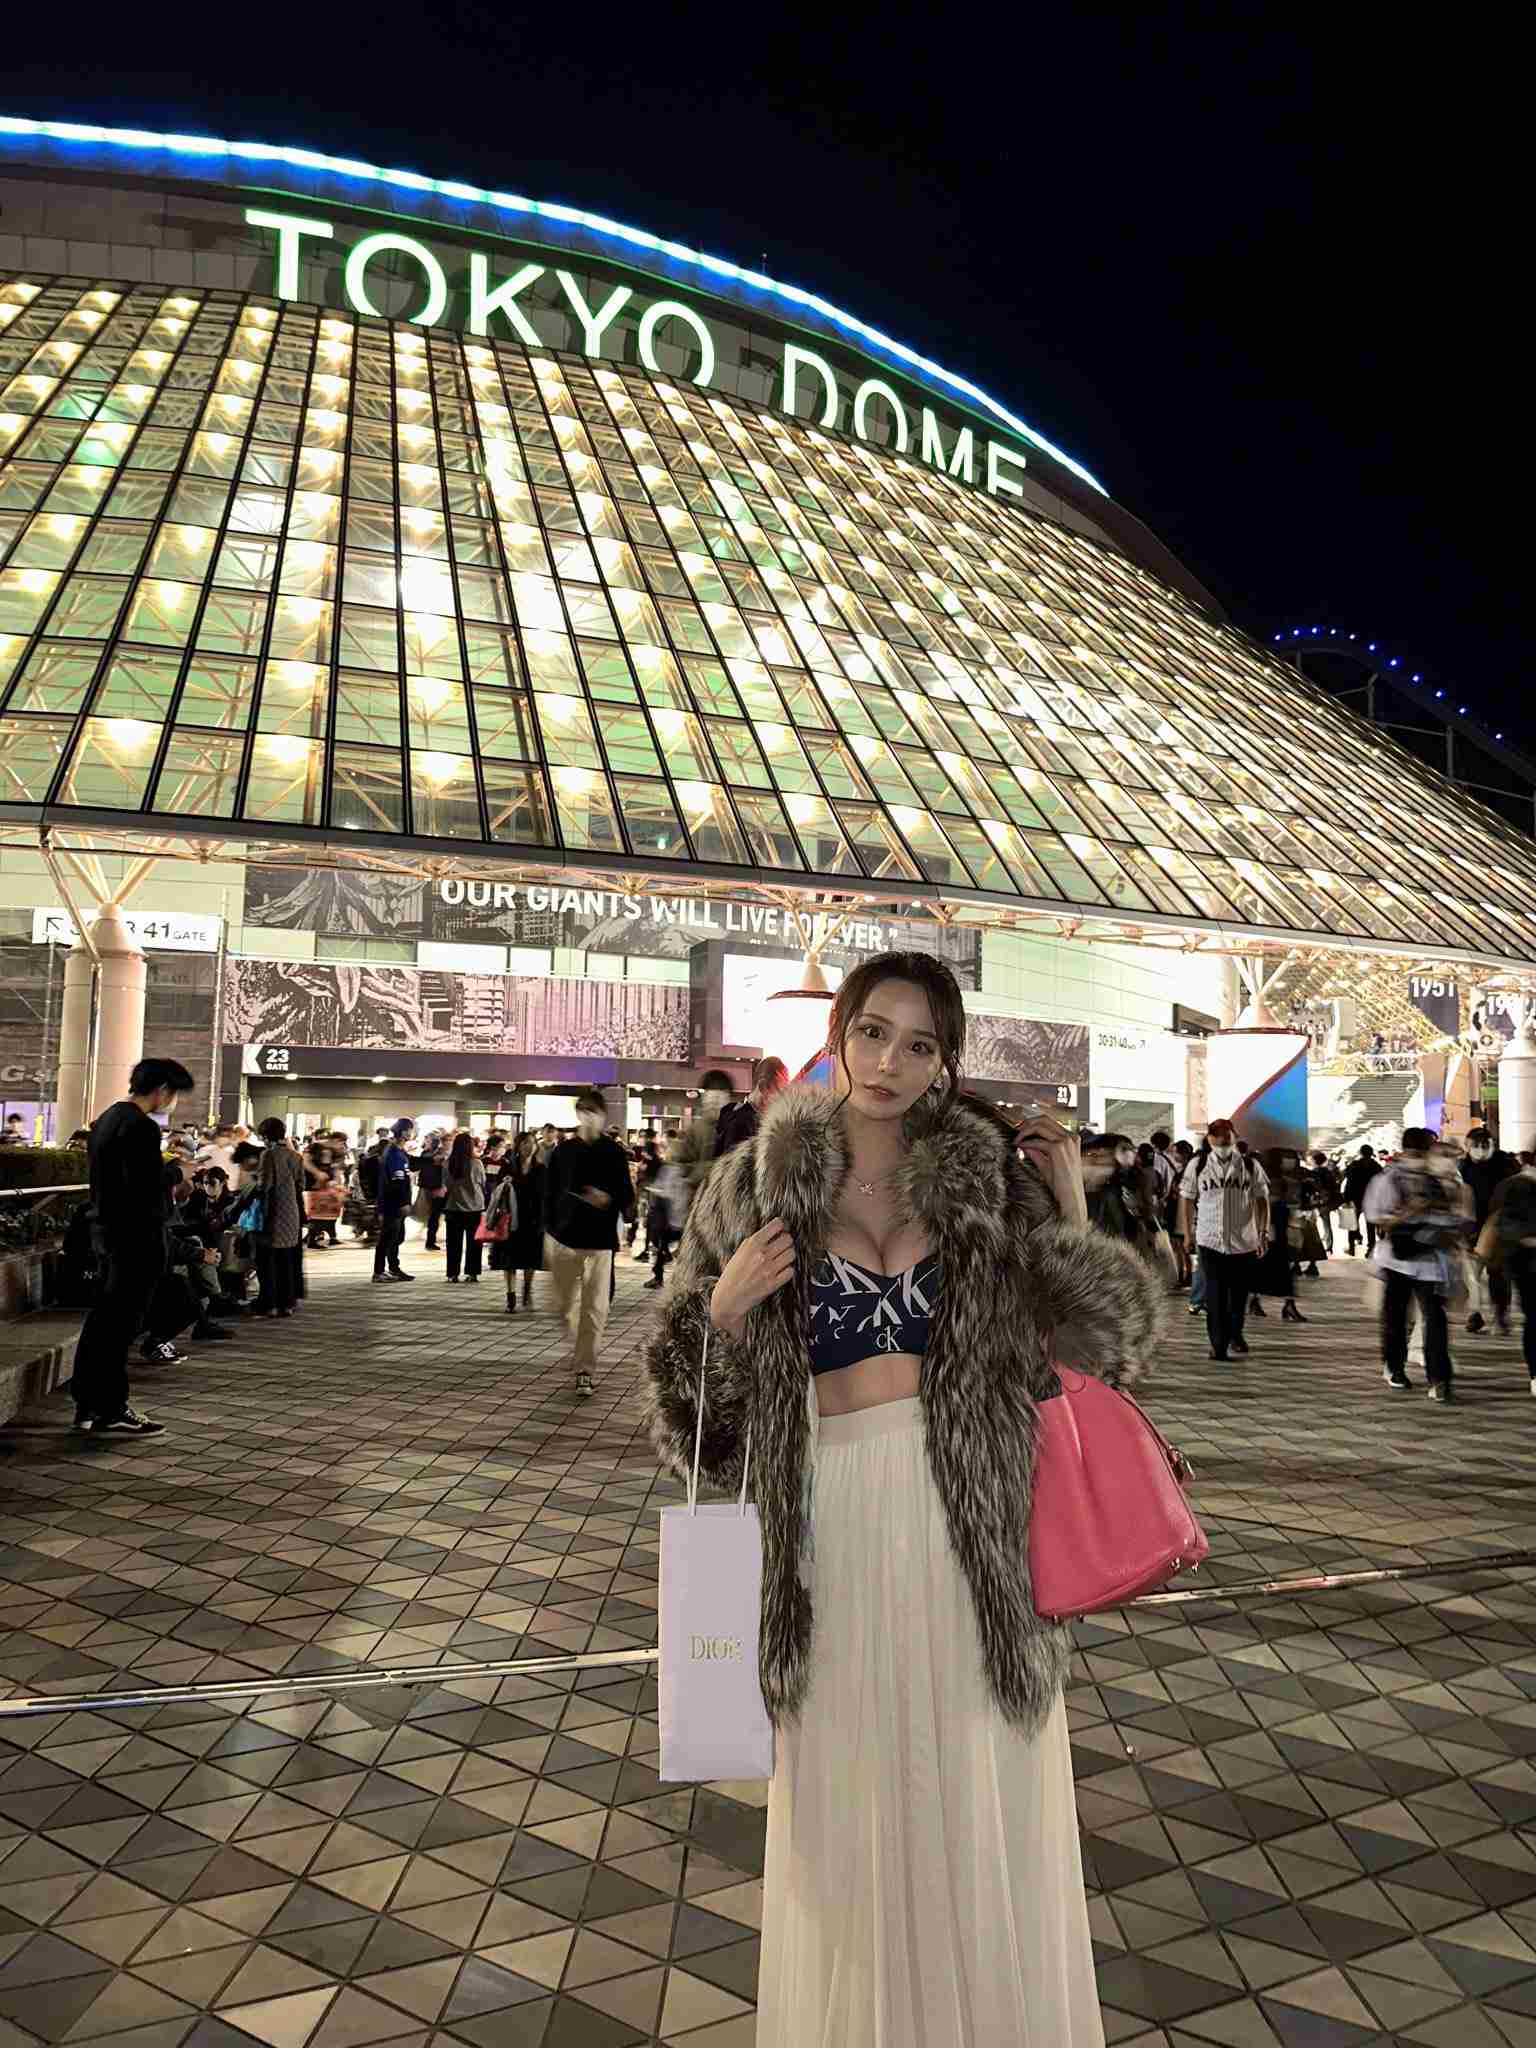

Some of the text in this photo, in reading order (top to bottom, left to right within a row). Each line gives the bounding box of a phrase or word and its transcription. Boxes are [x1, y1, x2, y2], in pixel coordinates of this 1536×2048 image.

[245, 208, 1027, 497] TOKYO DOME
[441, 879, 516, 909] OUR
[527, 886, 642, 920] GIANTS
[650, 895, 719, 928] WILL
[726, 903, 778, 936] LIVE
[266, 1048, 289, 1063] 23
